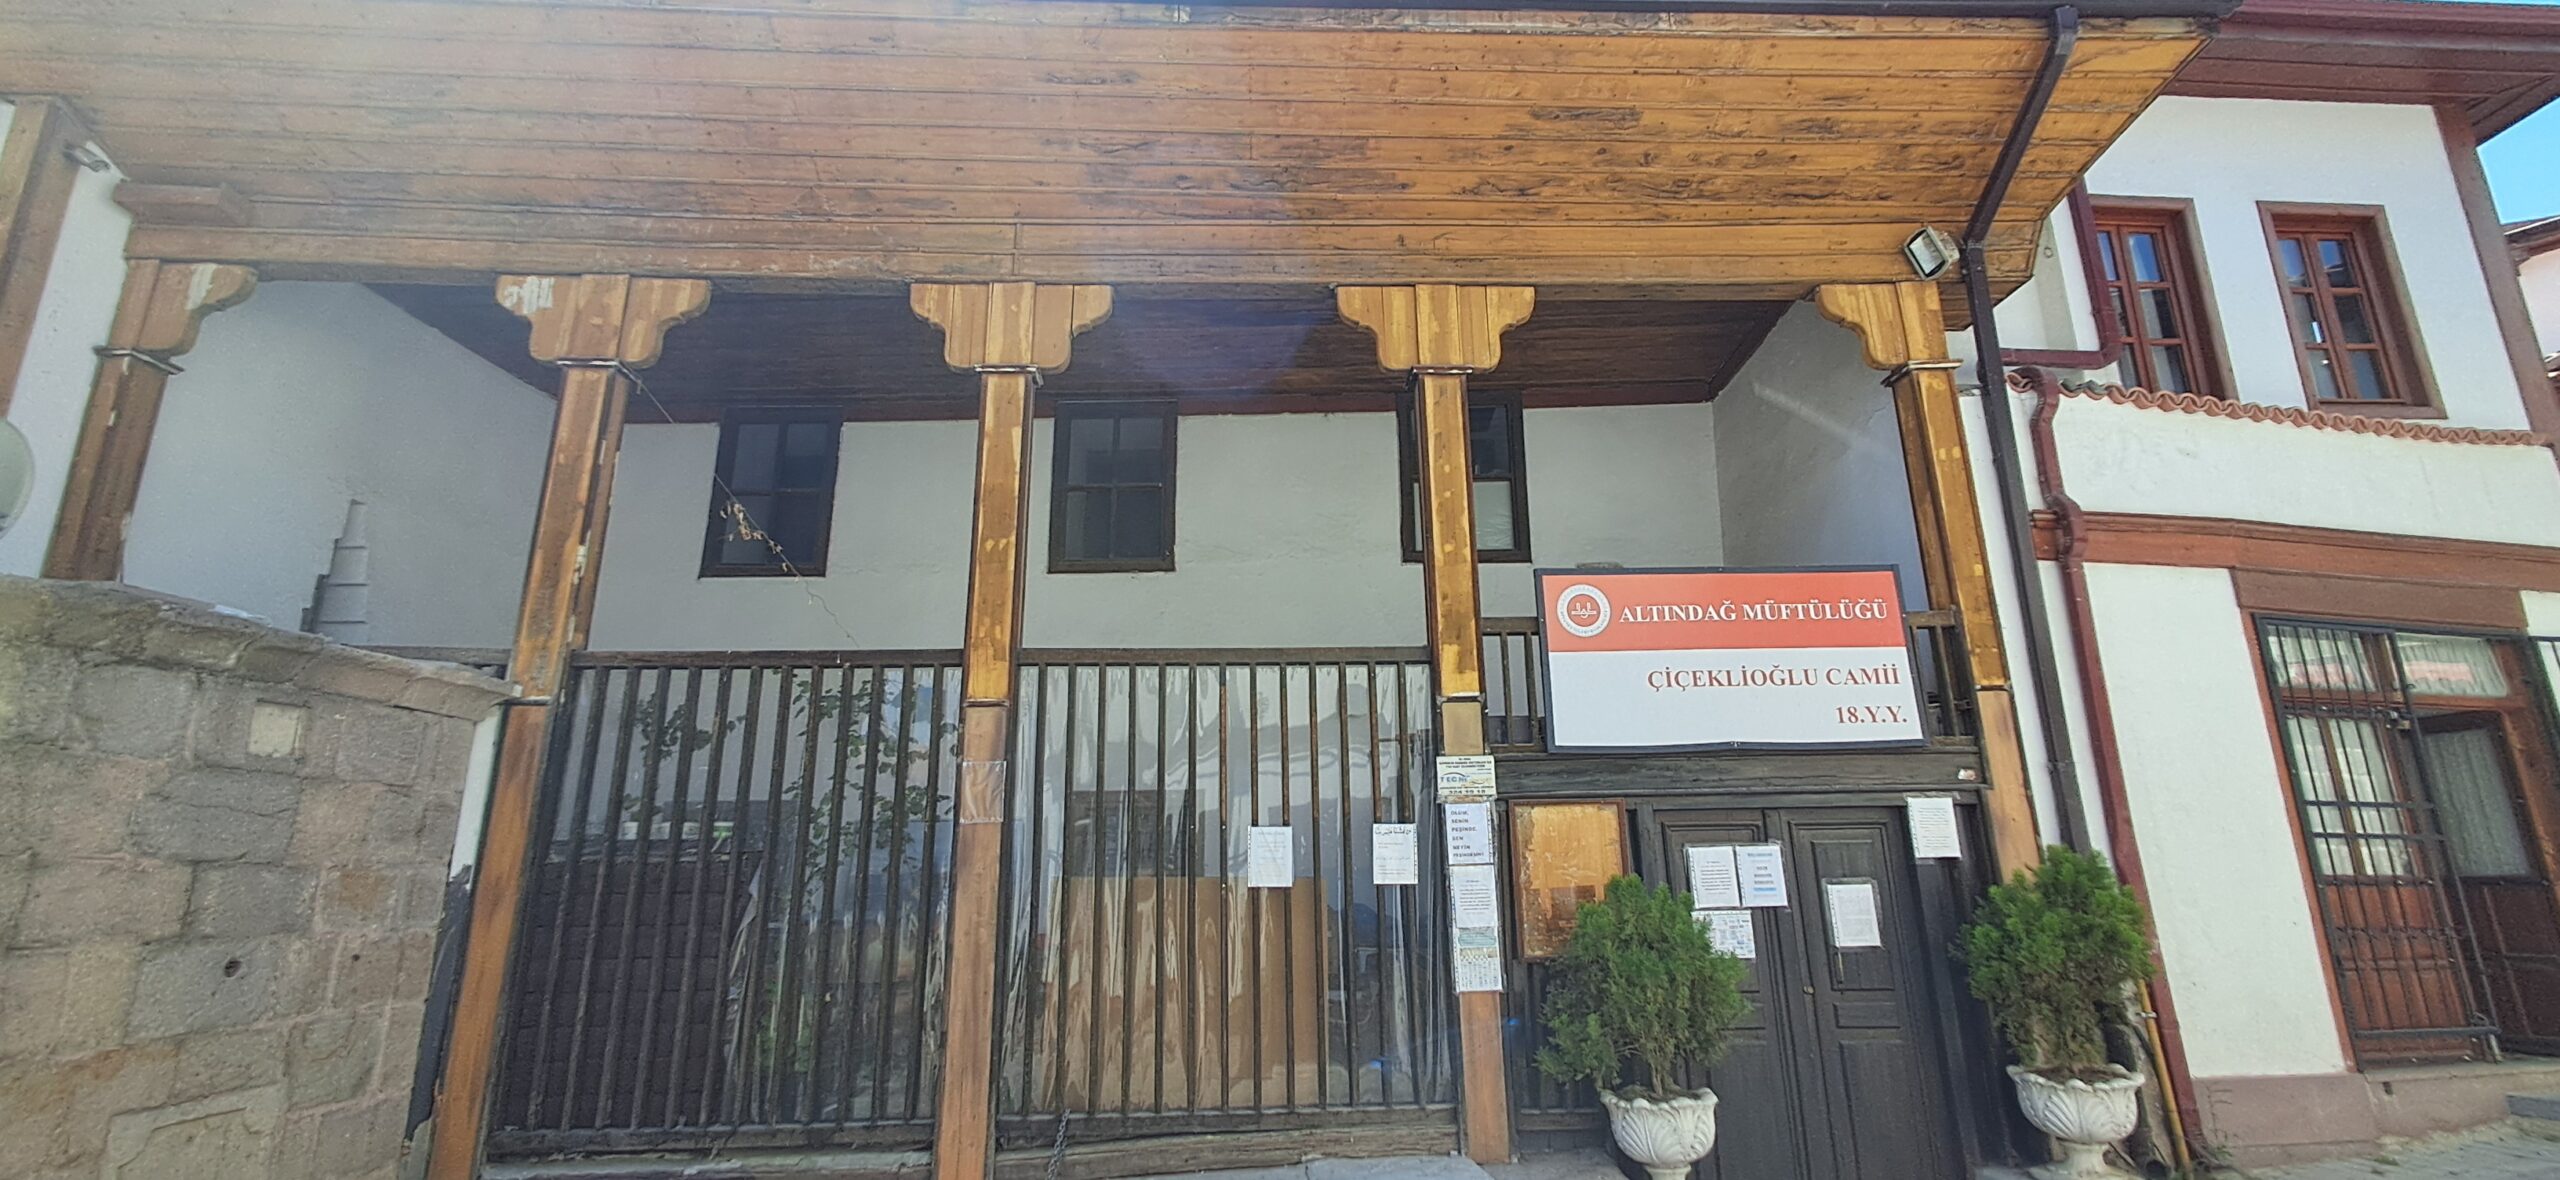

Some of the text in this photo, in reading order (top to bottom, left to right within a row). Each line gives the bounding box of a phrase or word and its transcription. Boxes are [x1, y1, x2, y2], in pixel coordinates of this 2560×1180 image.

[1619, 600, 1736, 623] ALTINDAĞ
[1743, 598, 1888, 621] MÜFTÜLÜĞÜ
[1647, 663, 1901, 692] ÇİÇEKLİOĞLU CAMİİ
[1836, 705, 1908, 724] 18.Y.Y.
